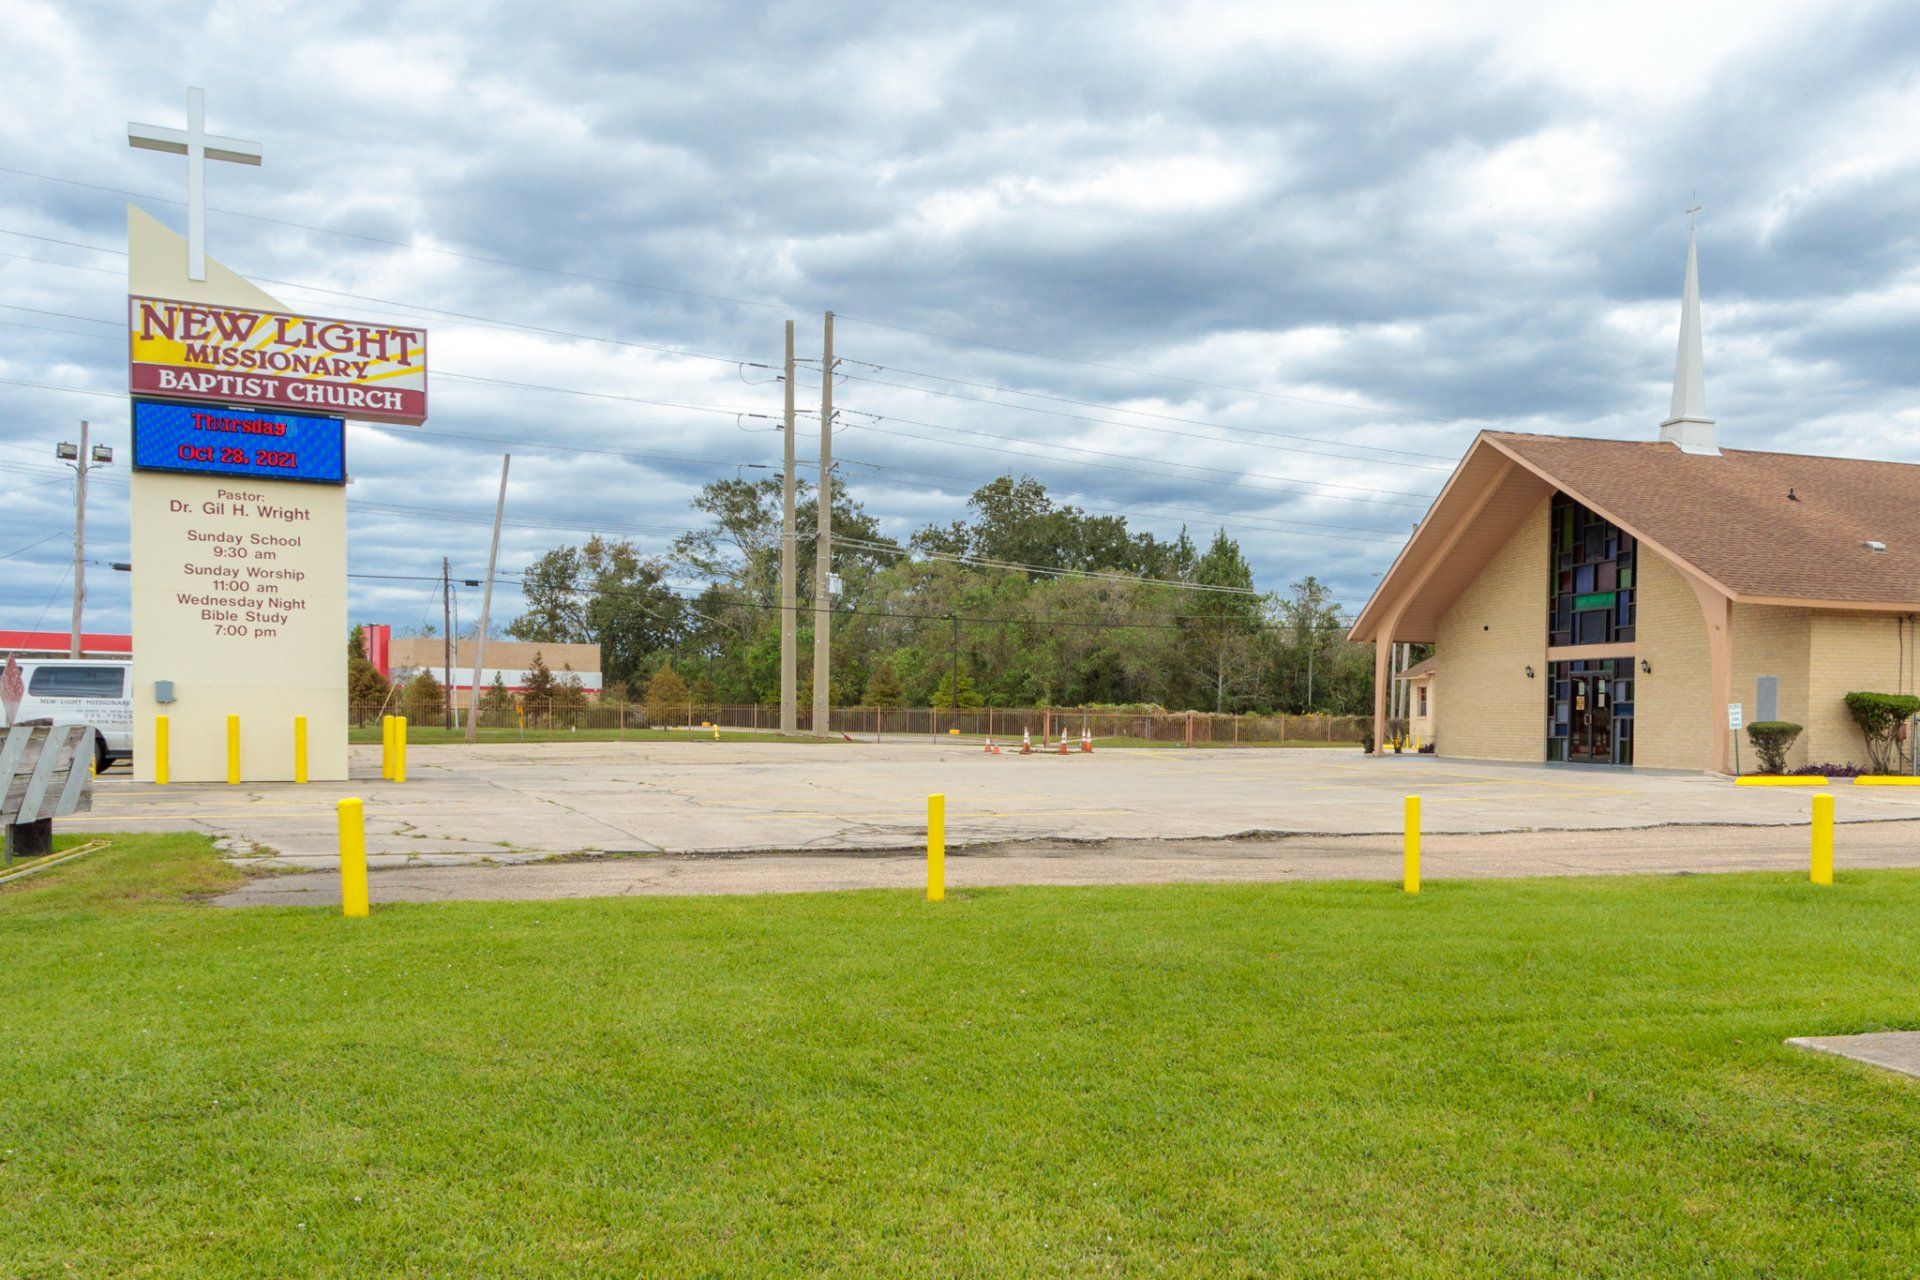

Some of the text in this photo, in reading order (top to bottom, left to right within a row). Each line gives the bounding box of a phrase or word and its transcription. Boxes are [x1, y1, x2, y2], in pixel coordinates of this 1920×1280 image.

[140, 304, 418, 367] NEW LIGHT
[184, 343, 370, 379] MISSIONARY
[158, 369, 403, 411] BAPTIST CHURCH
[192, 413, 287, 437] Thursday
[178, 443, 214, 462] Oct
[256, 450, 298, 469] 2021
[217, 489, 265, 502] Pastor:
[170, 500, 310, 522] Dr. Gil H. Wright
[187, 530, 301, 547] Sunday School
[213, 546, 276, 560] 9:30 am
[184, 563, 305, 582] Sunday Worship
[213, 580, 278, 593] 11:00 am
[177, 593, 306, 611] Wednesday Night
[201, 610, 288, 624] Bible Study
[214, 624, 276, 639] 7:00 pm
